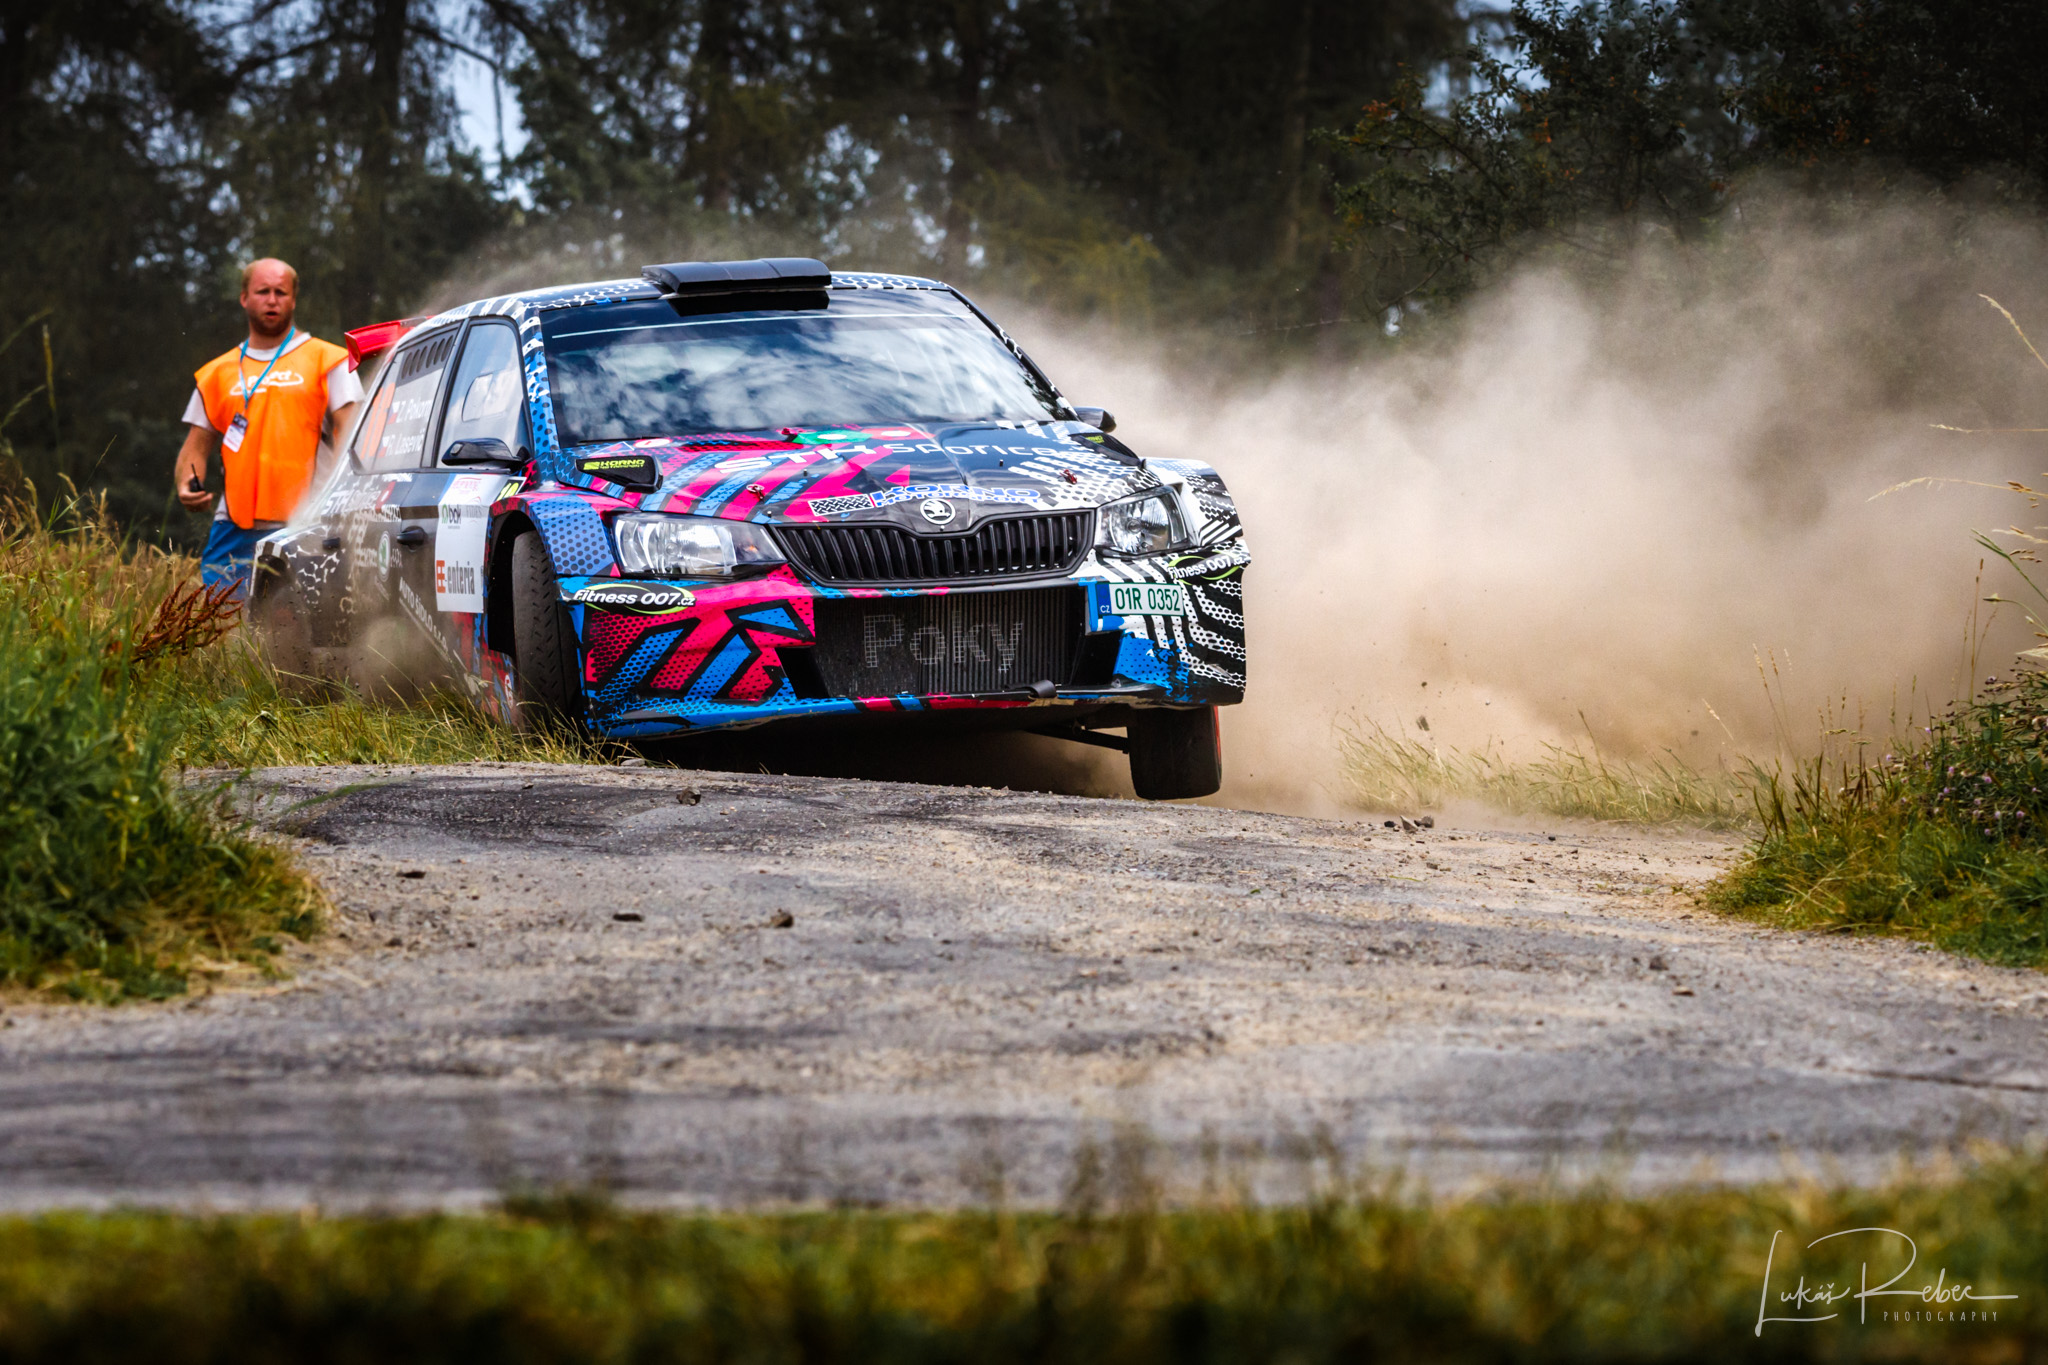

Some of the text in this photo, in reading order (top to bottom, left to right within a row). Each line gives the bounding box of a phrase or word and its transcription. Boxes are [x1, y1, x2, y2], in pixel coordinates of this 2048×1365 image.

[871, 483, 1041, 502] KORNO
[447, 561, 475, 594] enteria
[1100, 604, 1110, 613] CZ
[1114, 587, 1181, 612] 01R 0352
[864, 611, 1023, 673] Poky
